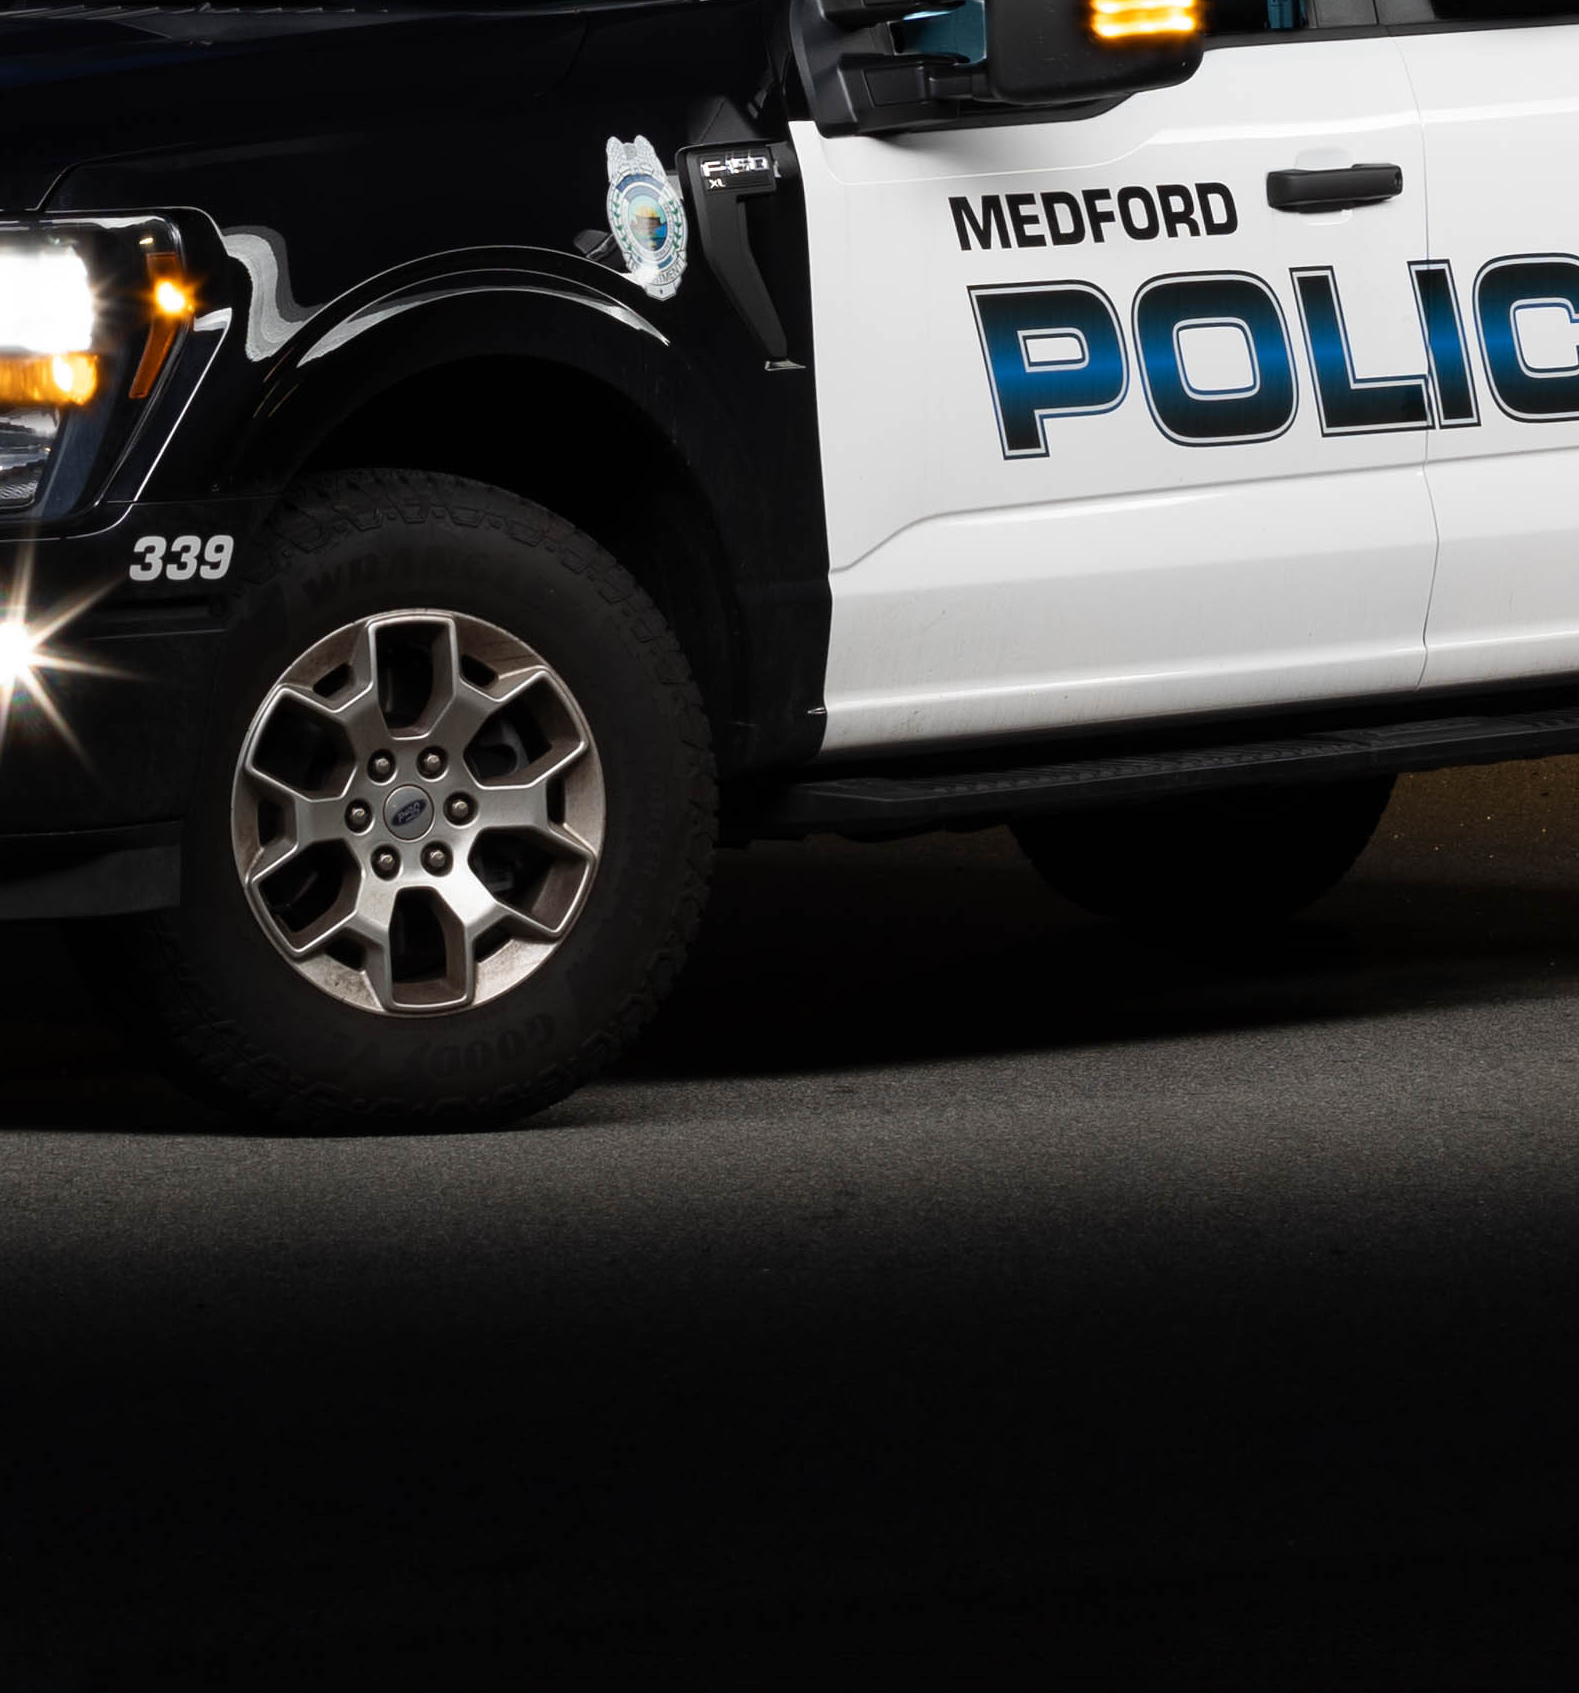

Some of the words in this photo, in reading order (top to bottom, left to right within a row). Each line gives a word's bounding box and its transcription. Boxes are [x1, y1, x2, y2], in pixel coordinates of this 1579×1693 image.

[708, 178, 726, 189] XL
[949, 182, 1238, 251] MEDFORD
[129, 534, 234, 581] 339
